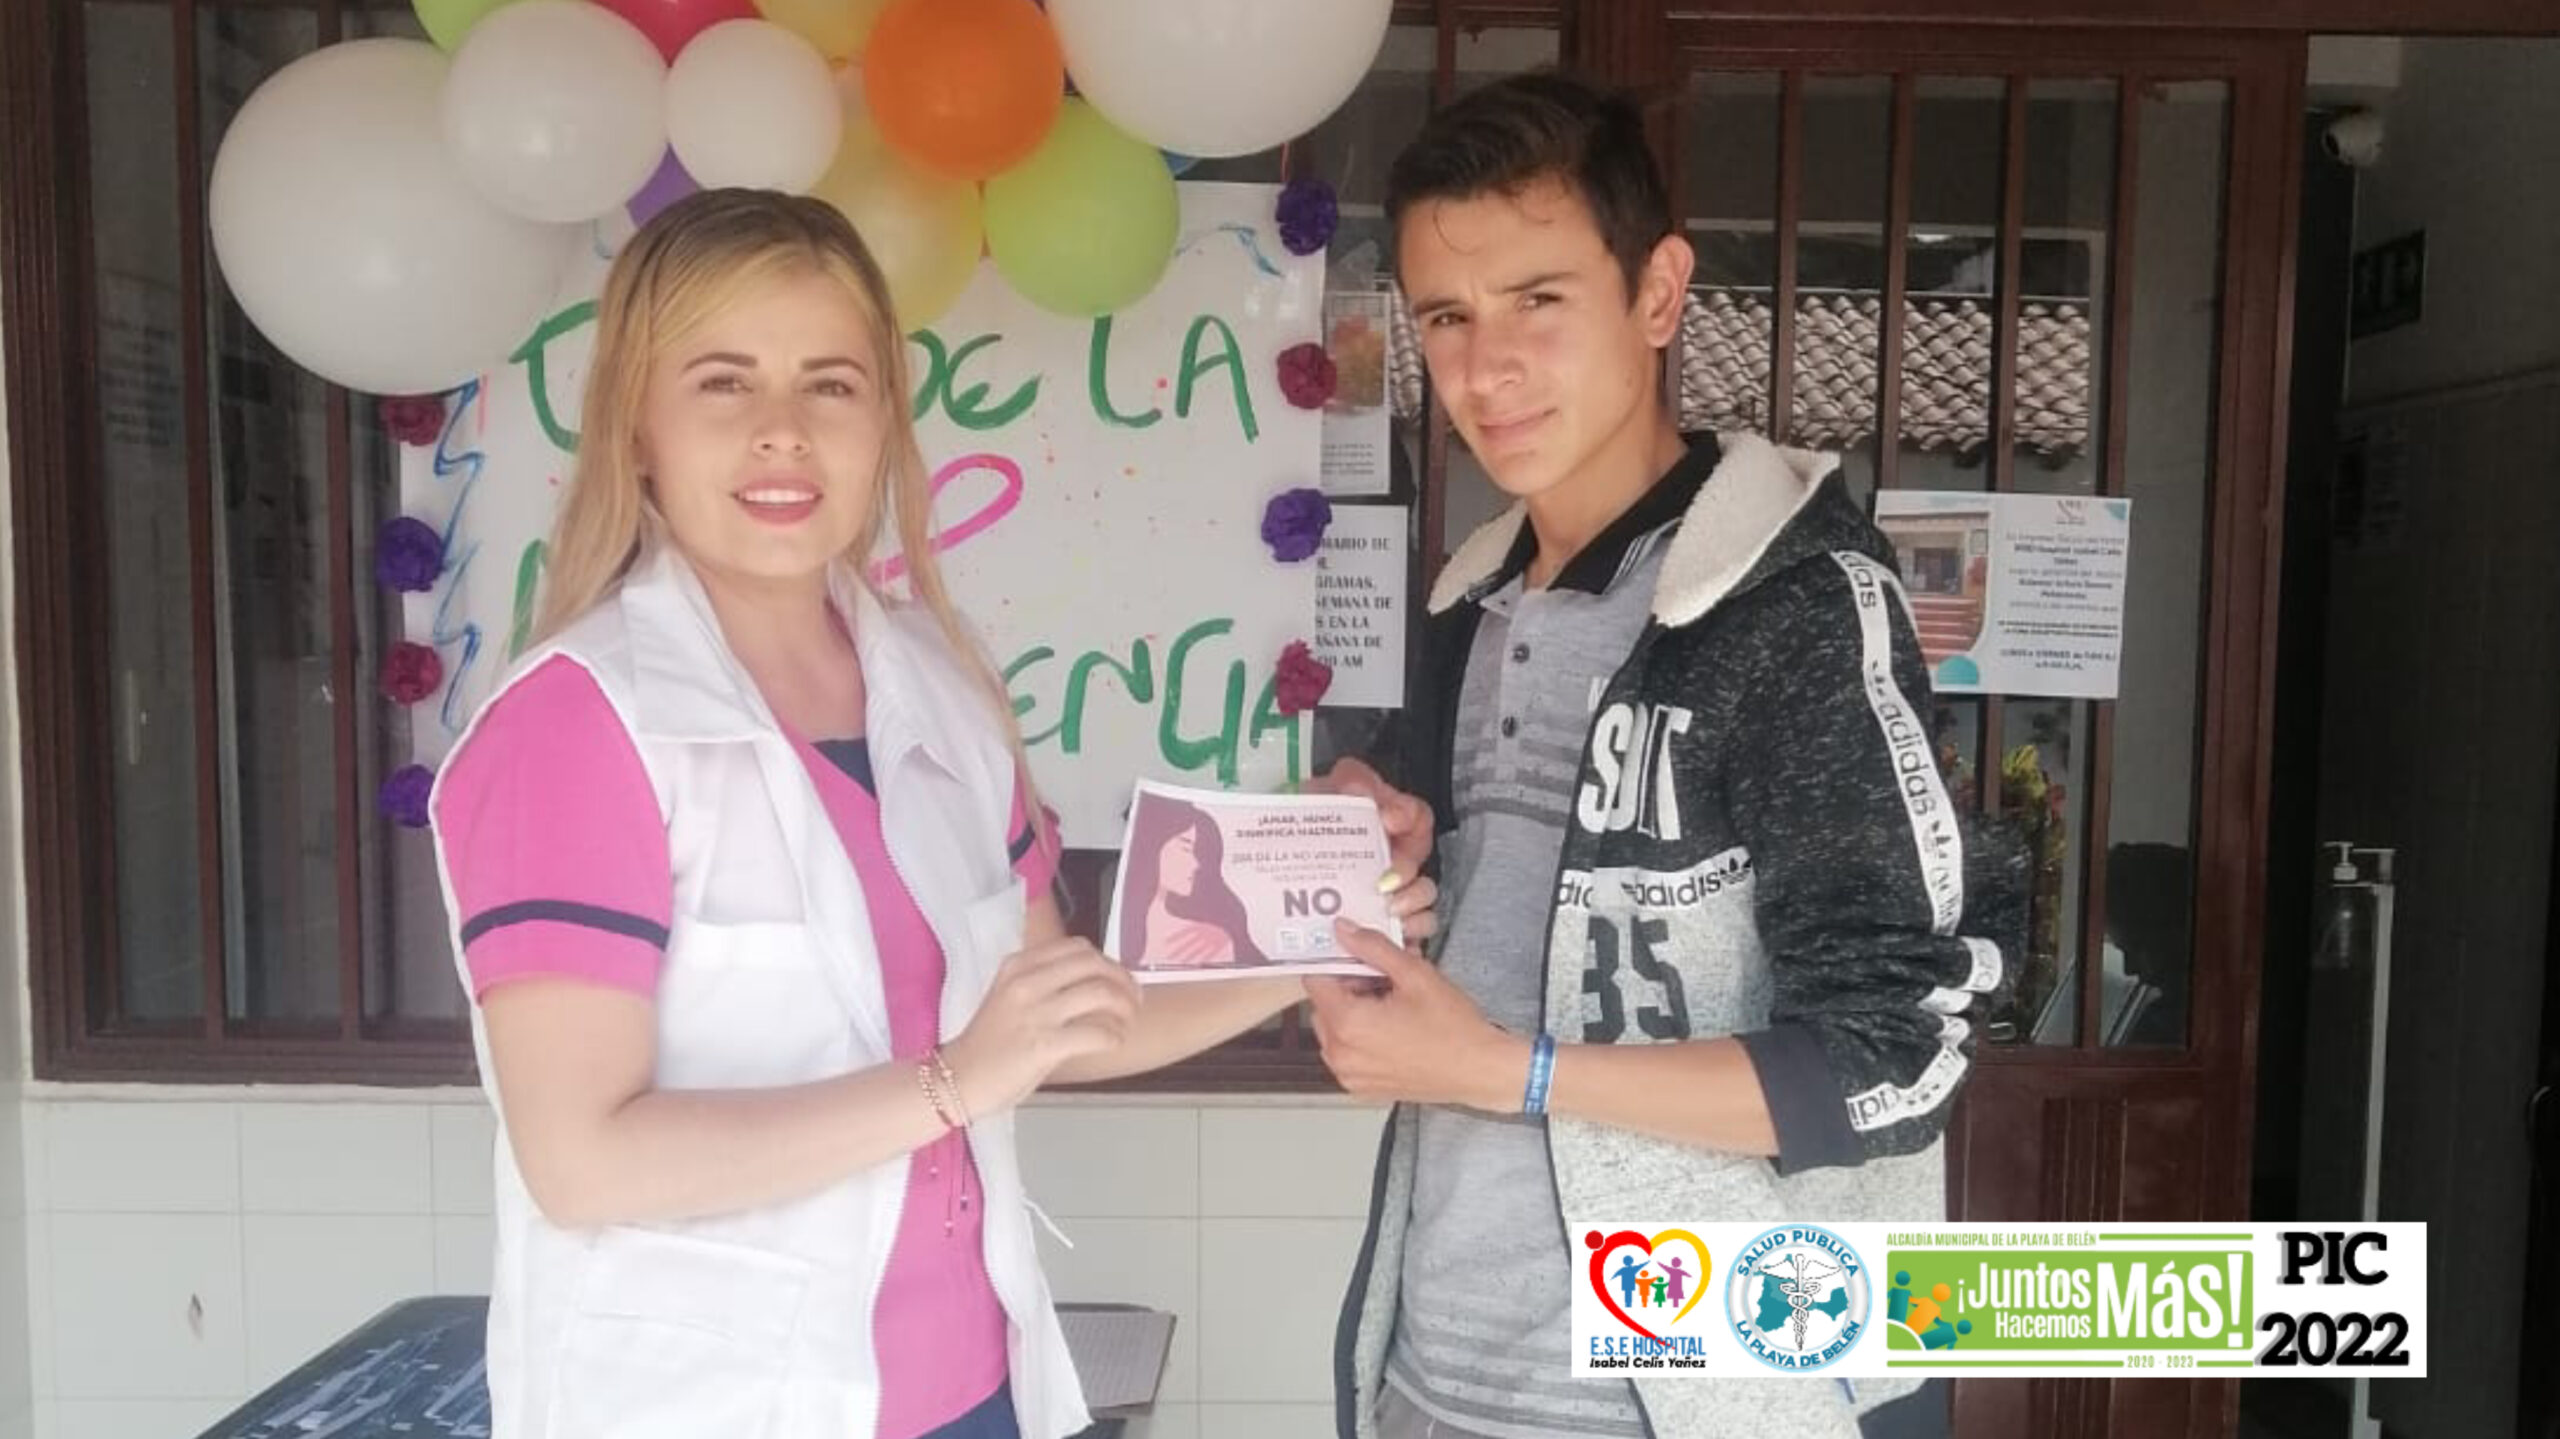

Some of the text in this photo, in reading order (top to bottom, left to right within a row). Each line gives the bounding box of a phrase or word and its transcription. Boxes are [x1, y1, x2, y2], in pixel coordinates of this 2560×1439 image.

[1088, 314, 1259, 443] LA
[1329, 616, 1347, 628] EN
[1351, 616, 1369, 629] LA
[1877, 701, 1937, 816] adidas
[1283, 887, 1342, 918] NO
